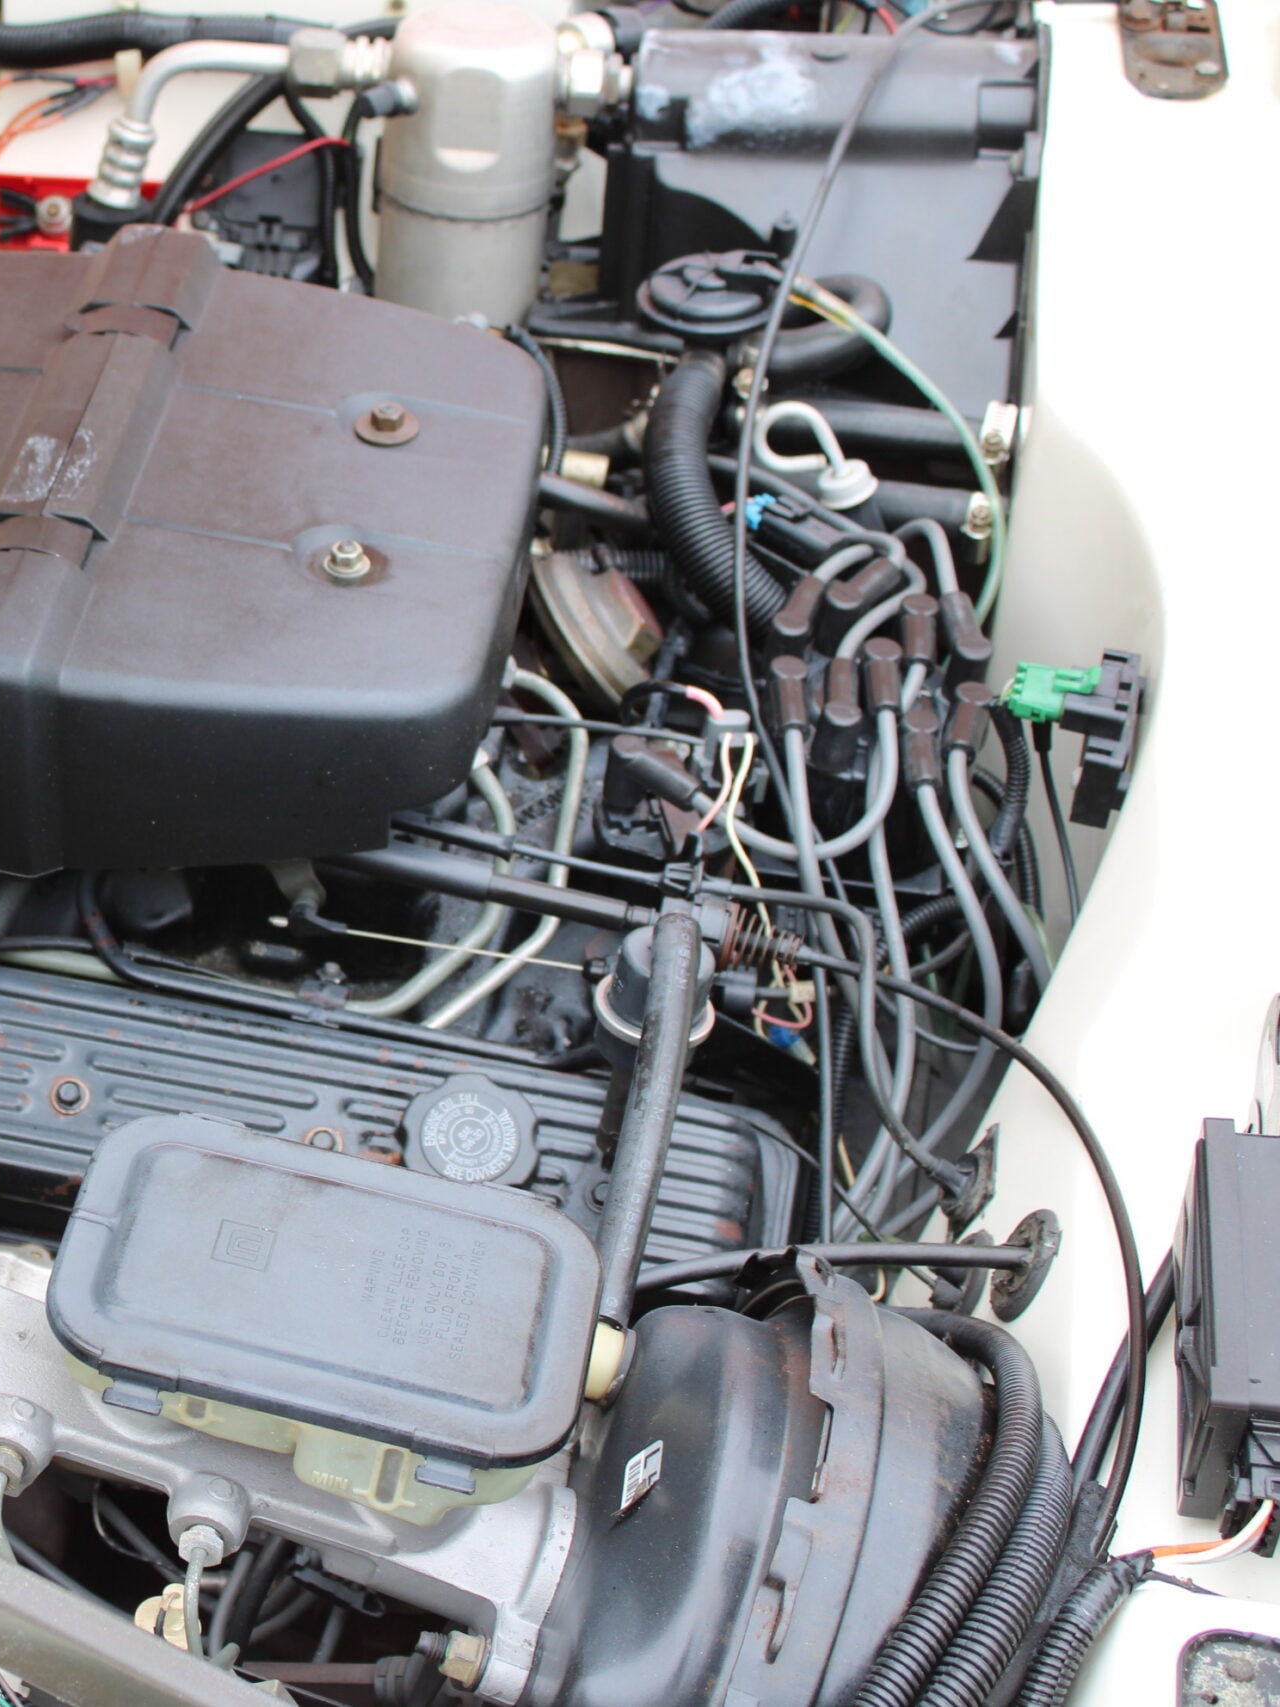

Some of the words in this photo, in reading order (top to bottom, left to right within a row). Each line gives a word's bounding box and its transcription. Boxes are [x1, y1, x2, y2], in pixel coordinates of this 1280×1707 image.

[423, 1108, 441, 1147] ENGINE
[438, 1097, 455, 1115] OIL
[458, 1093, 480, 1105] FILL
[442, 1163, 464, 1181] SEE
[498, 1107, 517, 1151] MANUAL
[360, 1249, 385, 1303] WARNING
[392, 1296, 415, 1346] BEFORE
[405, 1230, 431, 1290] REMOVING
[433, 1253, 449, 1278] DOT
[377, 1296, 397, 1339] CLEAN
[387, 1253, 407, 1295] FILLER
[424, 1282, 442, 1315] ONLY
[435, 1304, 455, 1341] FLUID
[445, 1265, 463, 1300] FROM
[449, 1312, 471, 1361] SEALED
[461, 1240, 487, 1307] CONTAINER
[418, 1320, 434, 1346] USE
[311, 1470, 350, 1491] MIN
